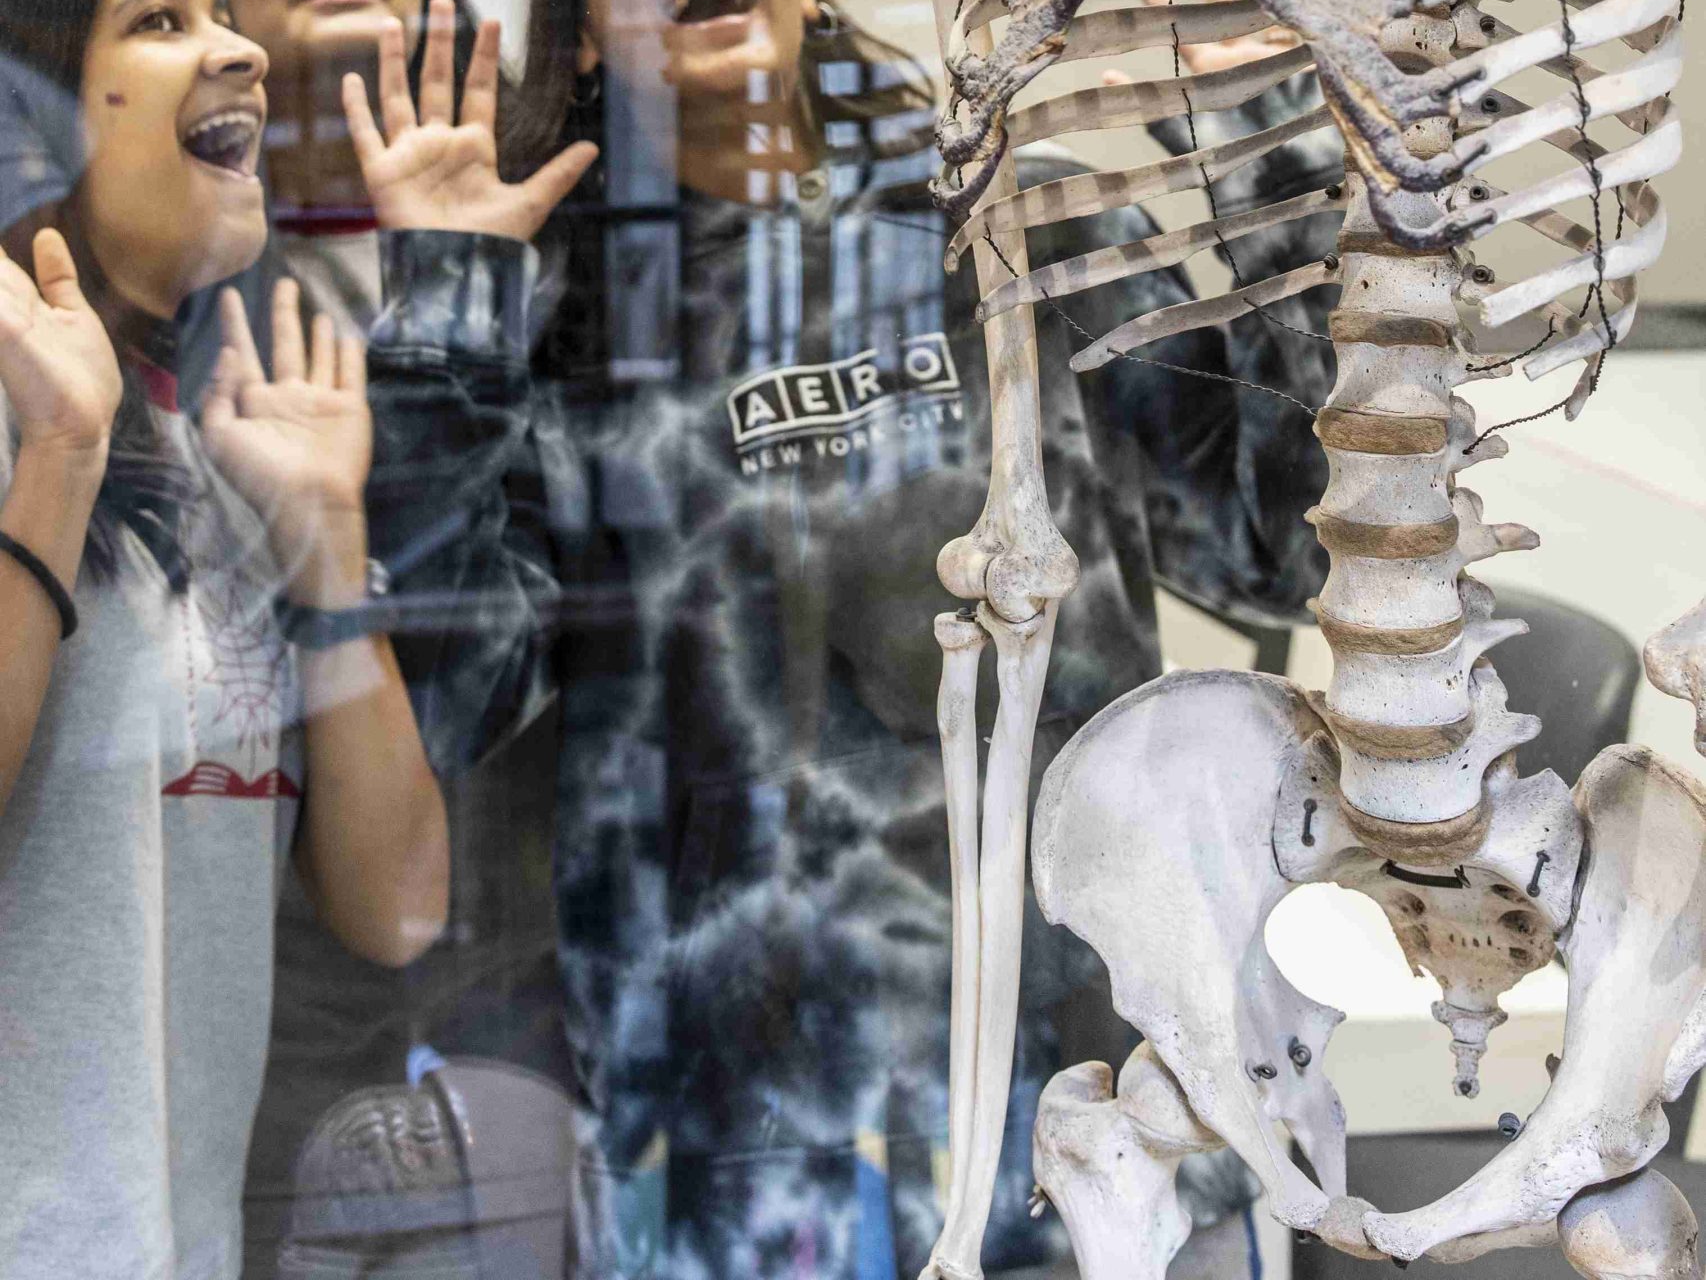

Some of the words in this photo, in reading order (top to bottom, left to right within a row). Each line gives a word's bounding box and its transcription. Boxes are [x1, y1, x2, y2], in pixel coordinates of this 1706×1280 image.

[745, 347, 942, 427] AERO
[741, 443, 801, 476] NEW
[814, 425, 885, 457] YORK
